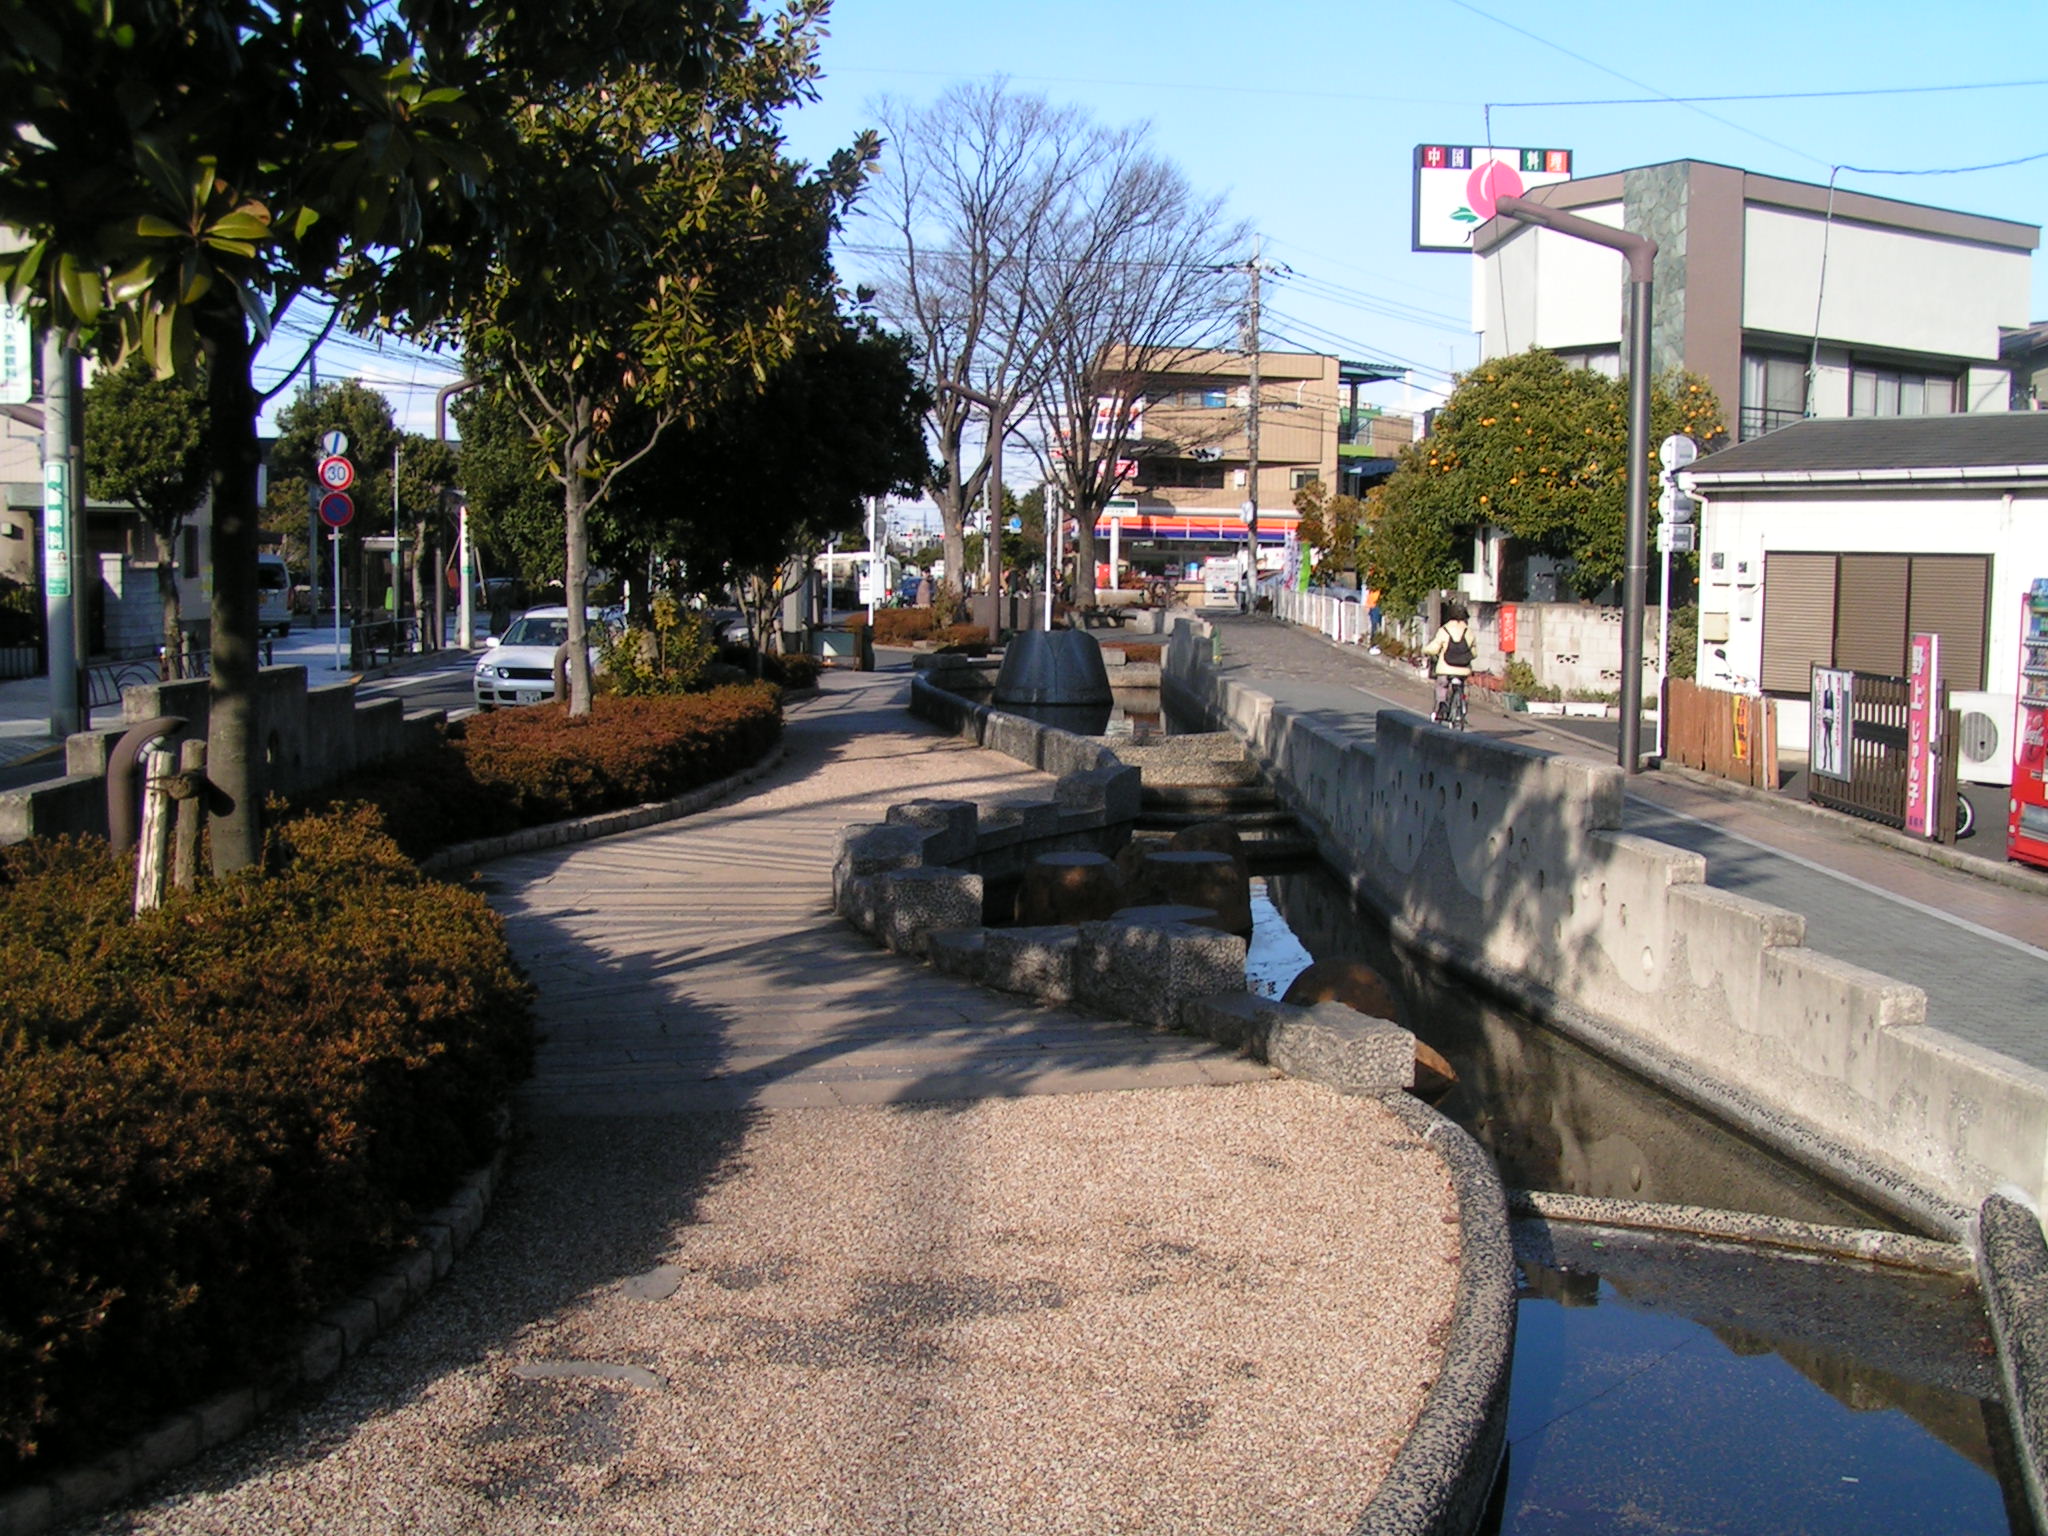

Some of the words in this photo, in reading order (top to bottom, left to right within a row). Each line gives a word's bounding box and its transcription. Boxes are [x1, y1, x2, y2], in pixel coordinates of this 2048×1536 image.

[1427, 146, 1465, 168] 中国
[1527, 149, 1563, 172] 料理
[327, 466, 346, 481] 30
